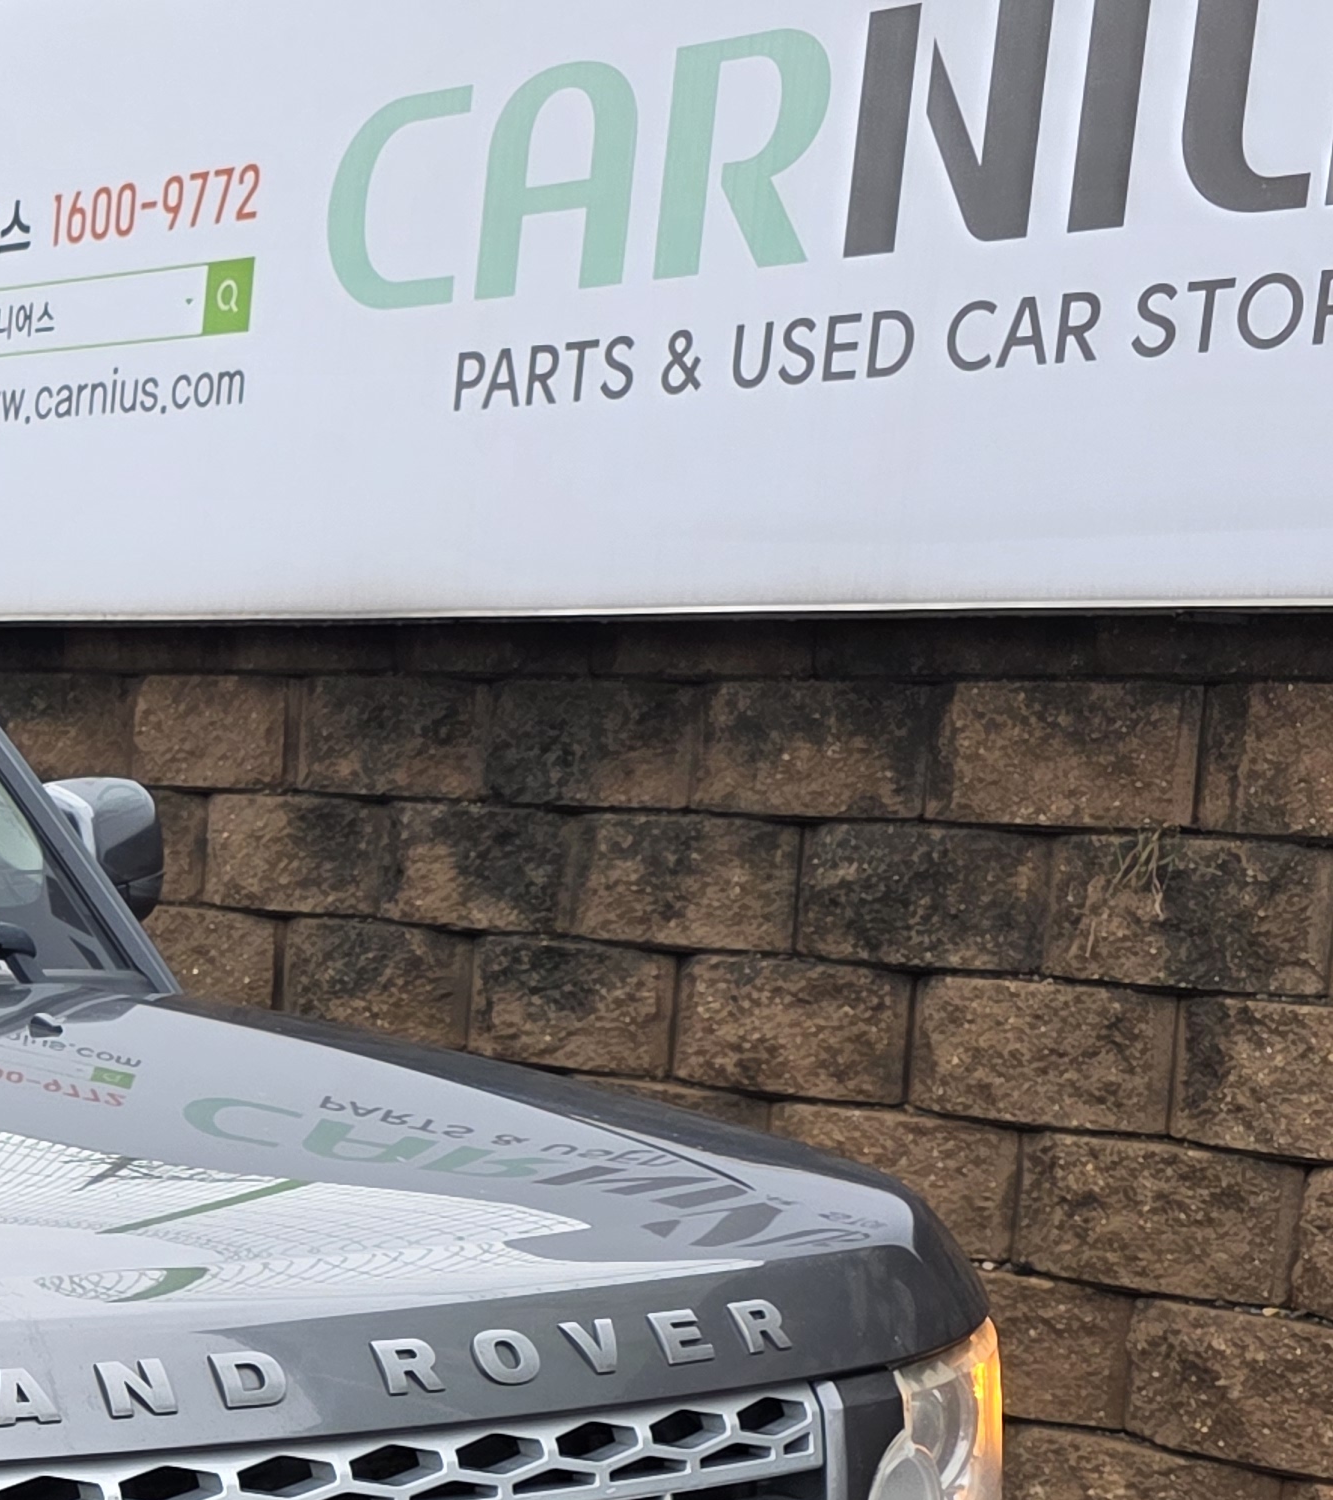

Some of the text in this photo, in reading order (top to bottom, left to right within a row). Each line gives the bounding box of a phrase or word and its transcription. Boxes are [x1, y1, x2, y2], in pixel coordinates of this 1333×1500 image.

[53, 163, 260, 247] 1600-9772
[452, 335, 635, 412] PARTS
[660, 330, 703, 395] &
[732, 308, 915, 389] USED
[945, 290, 1103, 372] CAR
[371, 1298, 792, 1395] ROVER
